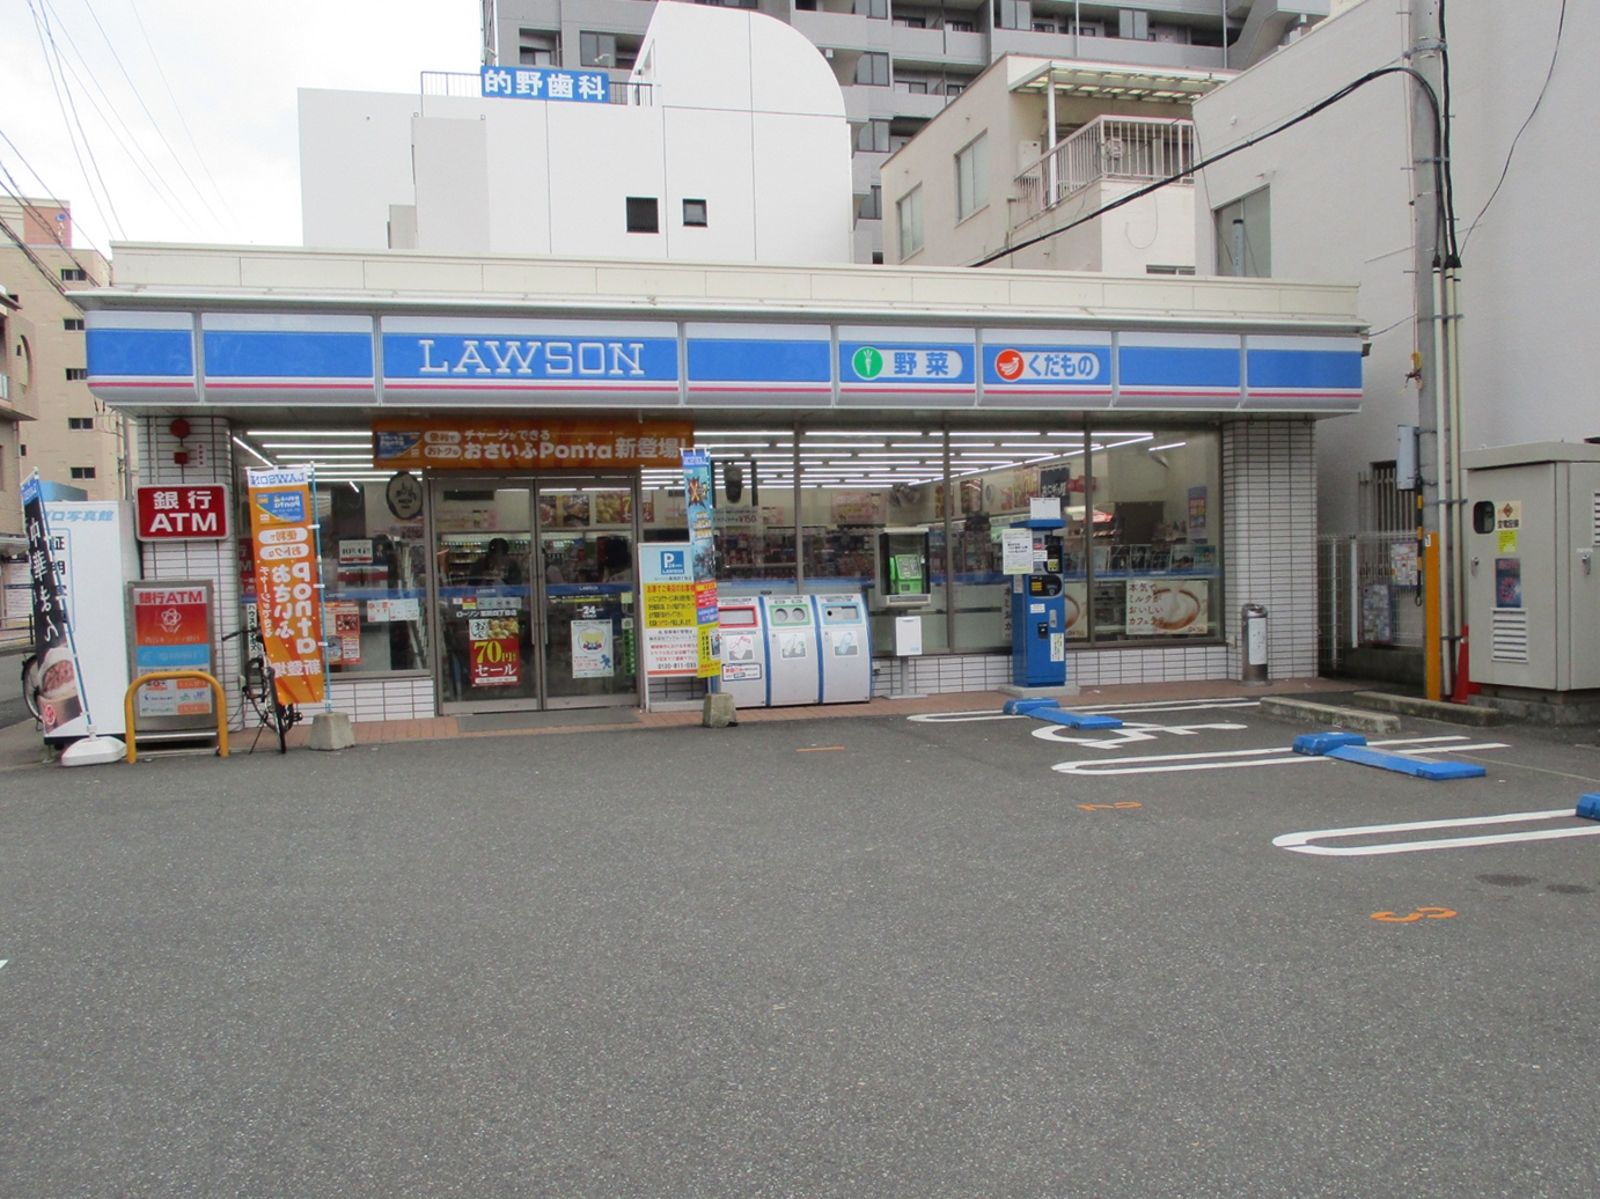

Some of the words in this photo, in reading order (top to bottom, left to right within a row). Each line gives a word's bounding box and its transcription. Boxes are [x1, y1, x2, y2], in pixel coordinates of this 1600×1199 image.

[484, 69, 606, 100] 的野歯科
[418, 339, 645, 375] LAWSON
[893, 351, 949, 376] 野菜
[1028, 353, 1094, 378] くだもの
[463, 429, 549, 441] チャージができる
[153, 490, 212, 510] 銀行
[150, 512, 218, 533] ATM
[663, 552, 675, 569] P
[28, 517, 59, 643] 中華まん
[582, 605, 597, 615] 24
[475, 664, 517, 677] セール
